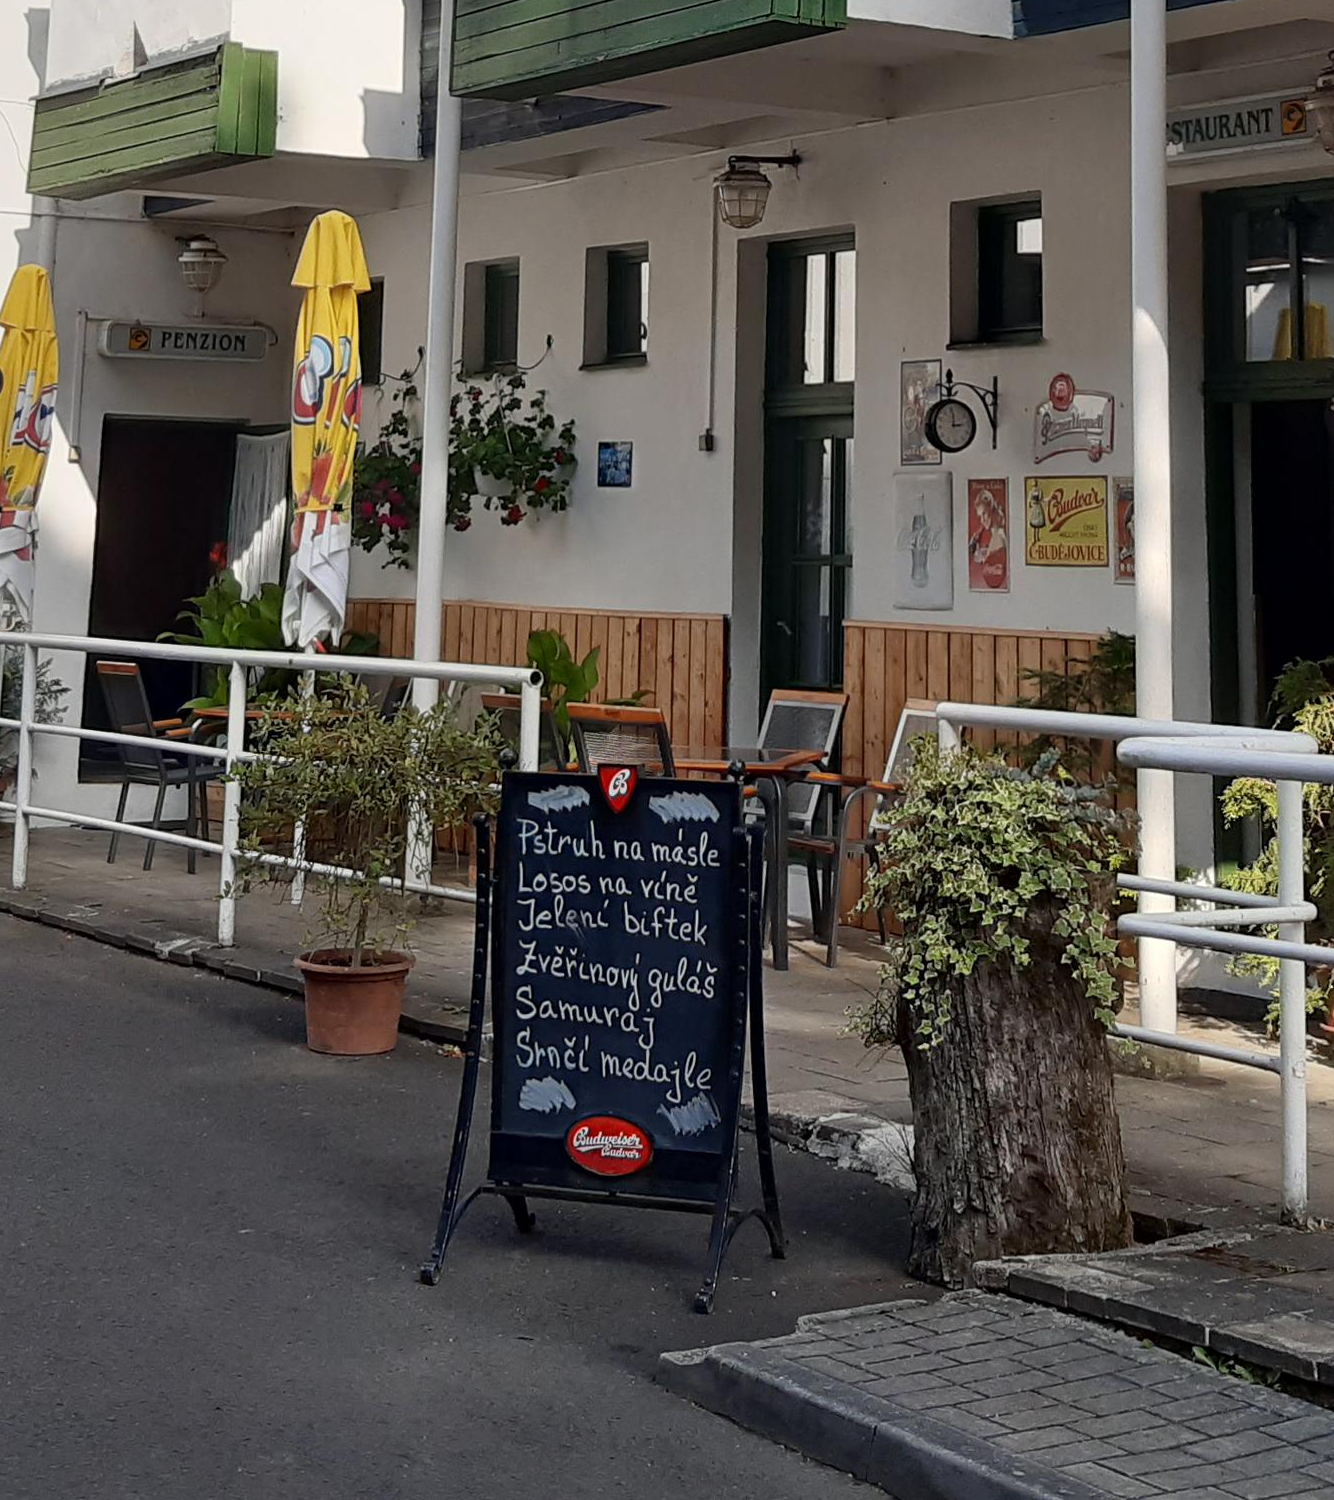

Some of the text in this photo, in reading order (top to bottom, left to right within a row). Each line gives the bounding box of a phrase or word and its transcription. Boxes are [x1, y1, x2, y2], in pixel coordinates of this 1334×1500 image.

[161, 331, 247, 351] PENZION
[516, 818, 721, 867] Pstruh na másle
[518, 861, 699, 904] Losos na víně
[516, 894, 708, 946] Jelení biftek
[516, 940, 718, 1011] Zvěřinový guláš
[516, 985, 655, 1050] Samuraj
[516, 1026, 712, 1104] Srnčí medajle
[573, 1126, 643, 1150] Budweiser
